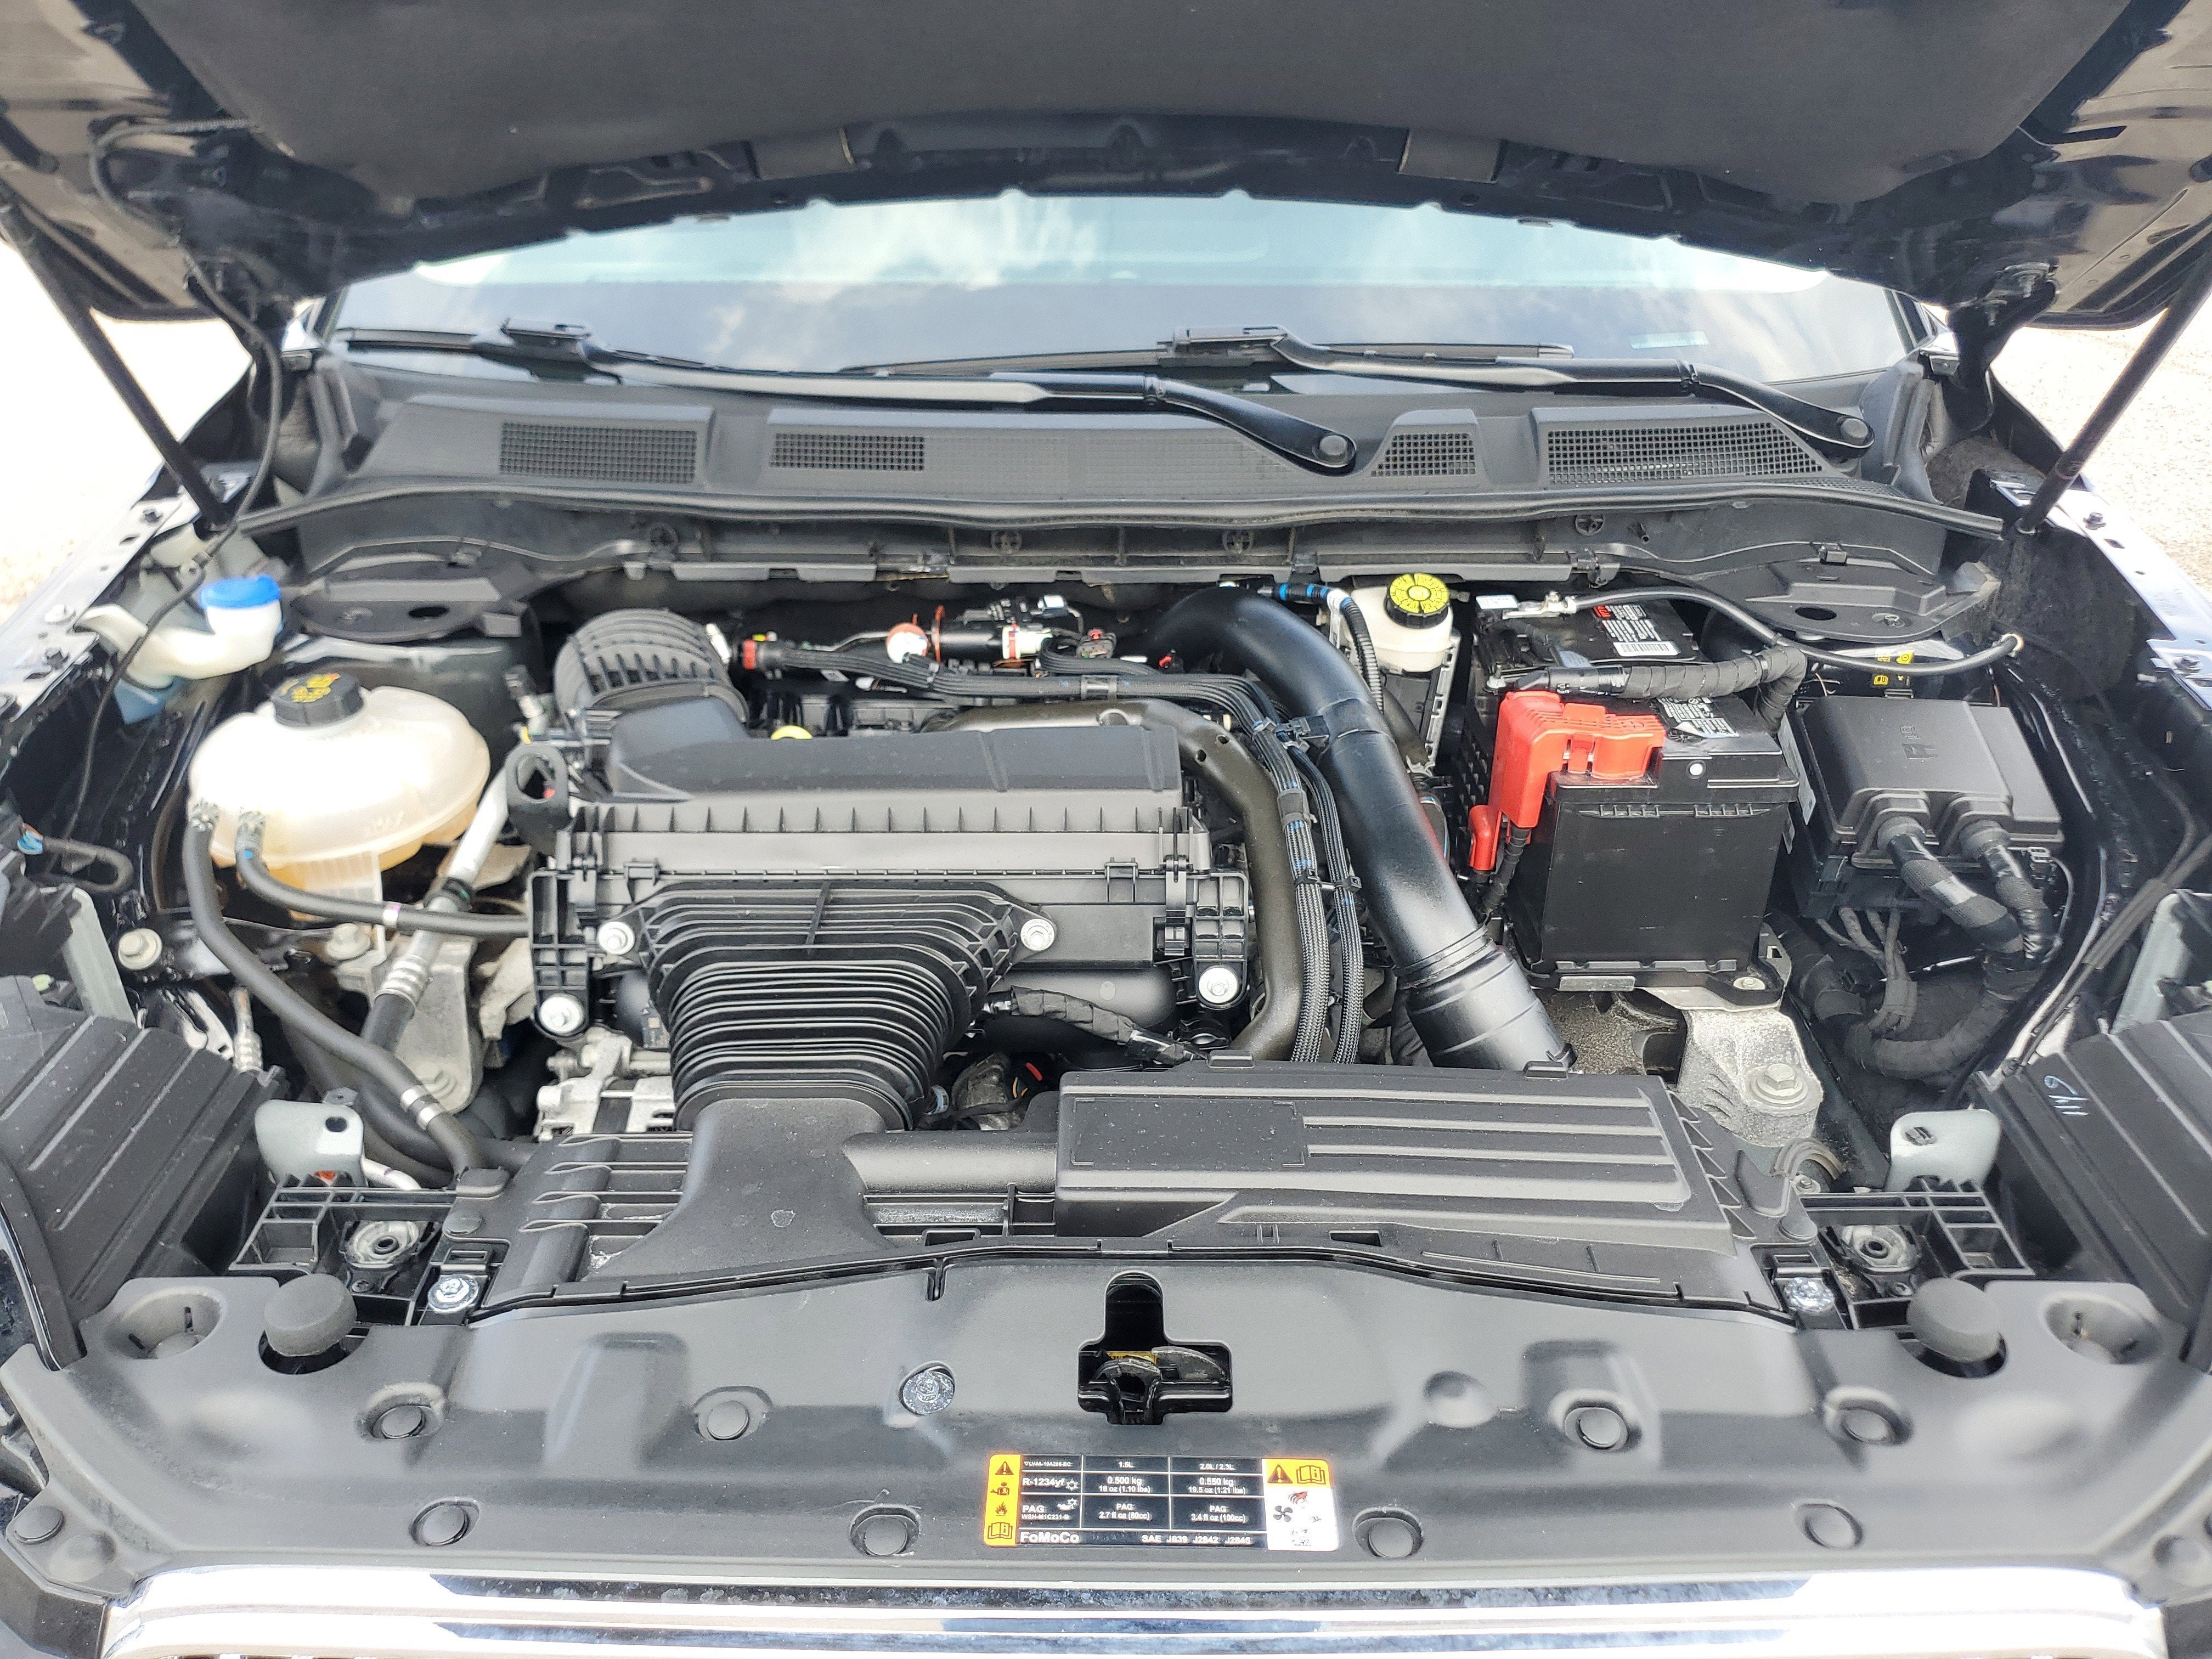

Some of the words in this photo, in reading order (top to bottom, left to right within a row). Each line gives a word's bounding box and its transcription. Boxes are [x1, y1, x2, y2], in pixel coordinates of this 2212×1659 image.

[1022, 1477, 1066, 1488] R-1234yf
[1131, 1476, 1142, 1486] kg
[1199, 1477, 1222, 1486] 0.550
[1223, 1478, 1234, 1487] kg
[1022, 1505, 1045, 1513] PAG
[1190, 1513, 1203, 1521] 3.4
[1220, 1514, 1246, 1523] (100cc)
[1020, 1531, 1080, 1543] FoMoCo
[1192, 1536, 1219, 1544] J2842
[1224, 1536, 1251, 1544] J2845
